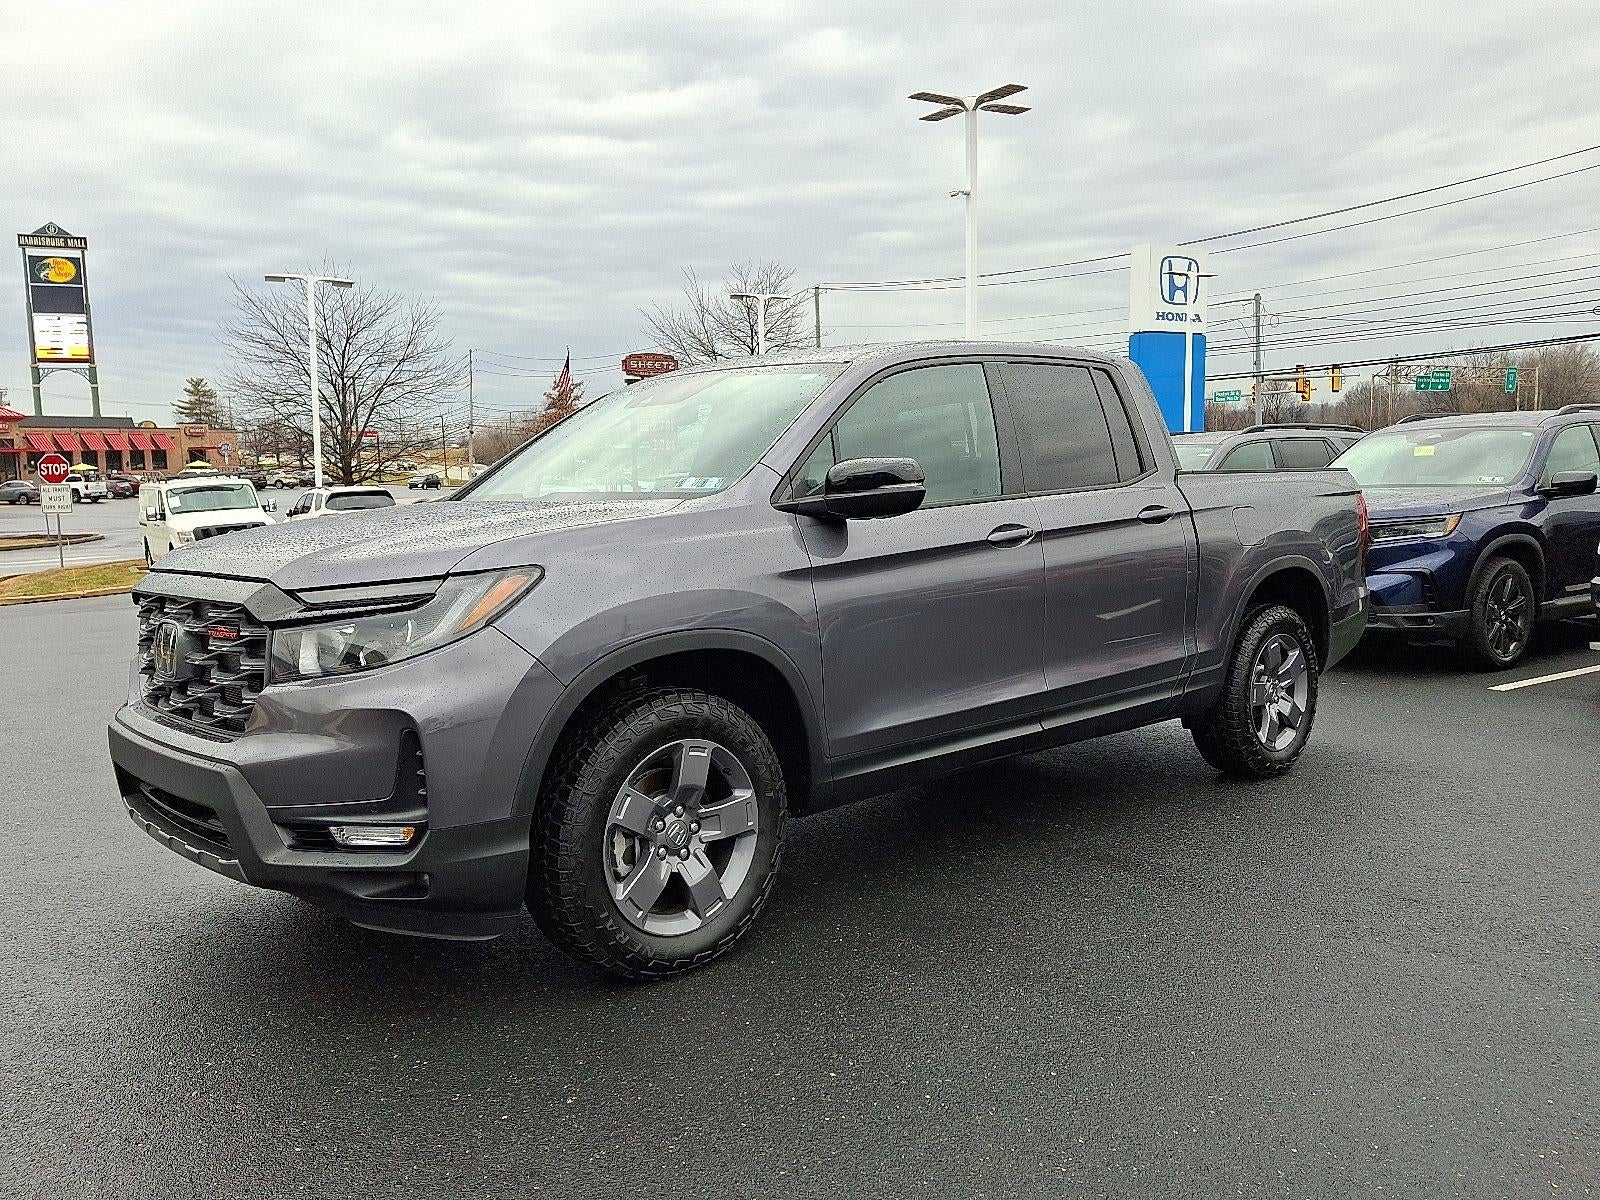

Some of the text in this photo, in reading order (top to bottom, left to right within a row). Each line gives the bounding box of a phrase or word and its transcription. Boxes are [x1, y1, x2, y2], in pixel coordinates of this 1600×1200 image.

[19, 236, 86, 248] HARRISBURG MALL
[1155, 311, 1203, 323] HONA
[630, 360, 675, 370] SHEETZ
[40, 463, 68, 476] STOP
